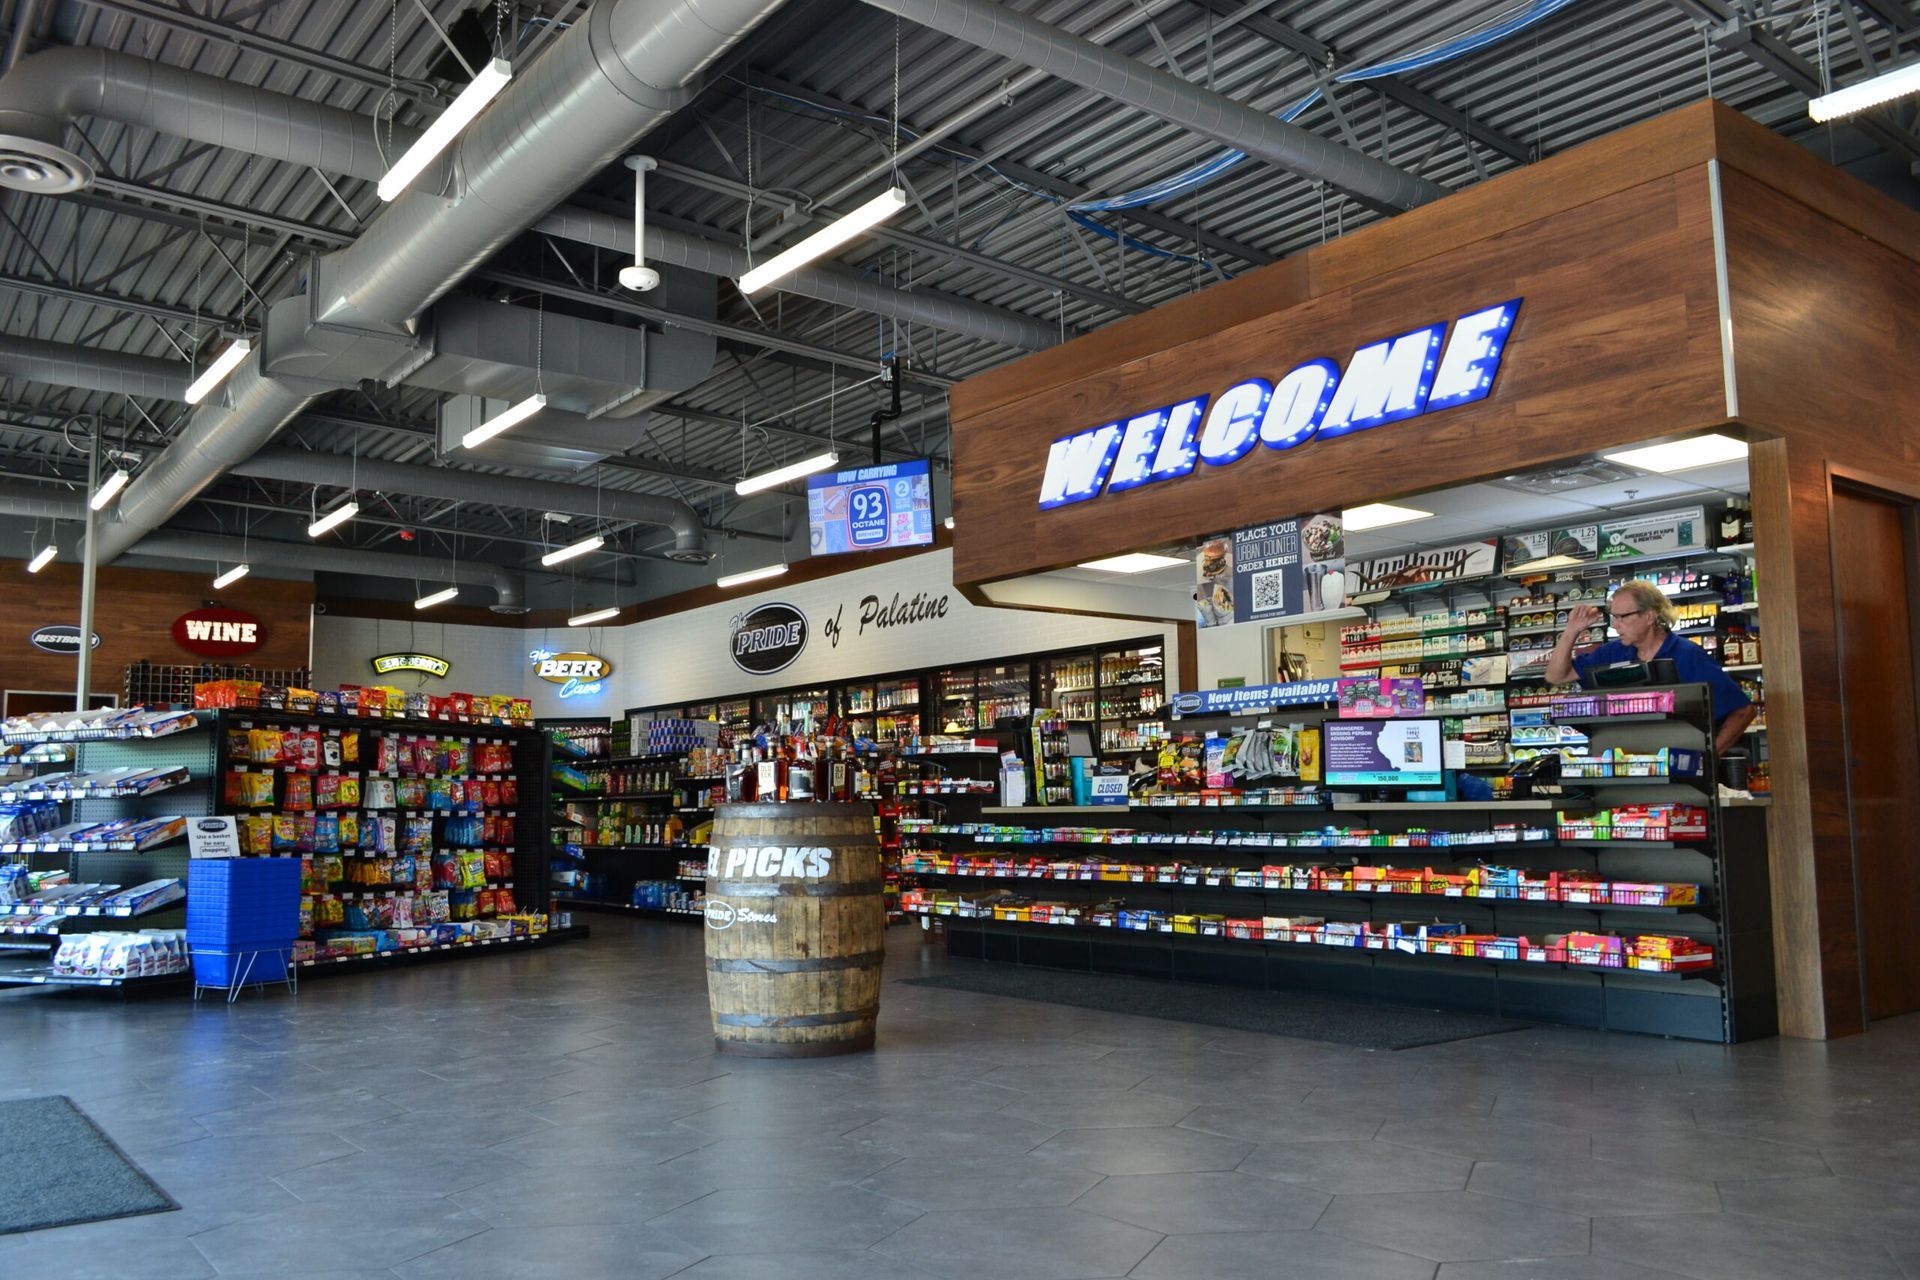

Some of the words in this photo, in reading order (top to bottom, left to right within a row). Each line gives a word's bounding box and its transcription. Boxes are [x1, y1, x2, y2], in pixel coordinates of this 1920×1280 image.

[1039, 298, 1522, 510] WELCOME
[837, 472, 857, 484] NOW
[858, 465, 898, 481] CARRYING
[853, 492, 883, 520] 93
[852, 519, 886, 529] OCTANE
[1236, 526, 1267, 543] PLACE
[1269, 521, 1297, 537] YOUR
[1236, 543, 1260, 561] URBAN
[1263, 535, 1298, 556] COUNTER
[1236, 561, 1265, 573] ORDER
[1265, 555, 1298, 569] HERE!!!
[186, 620, 257, 643] WINE
[825, 603, 843, 648] of
[860, 592, 948, 636] Palatine
[736, 620, 801, 655] PRIDE
[538, 660, 603, 677] BEER
[560, 679, 602, 699] Cave
[1208, 692, 1233, 705] New
[1234, 689, 1269, 702] Items
[1271, 682, 1329, 699] Available
[1098, 783, 1123, 794] CLOSED
[724, 846, 832, 878] PICKS
